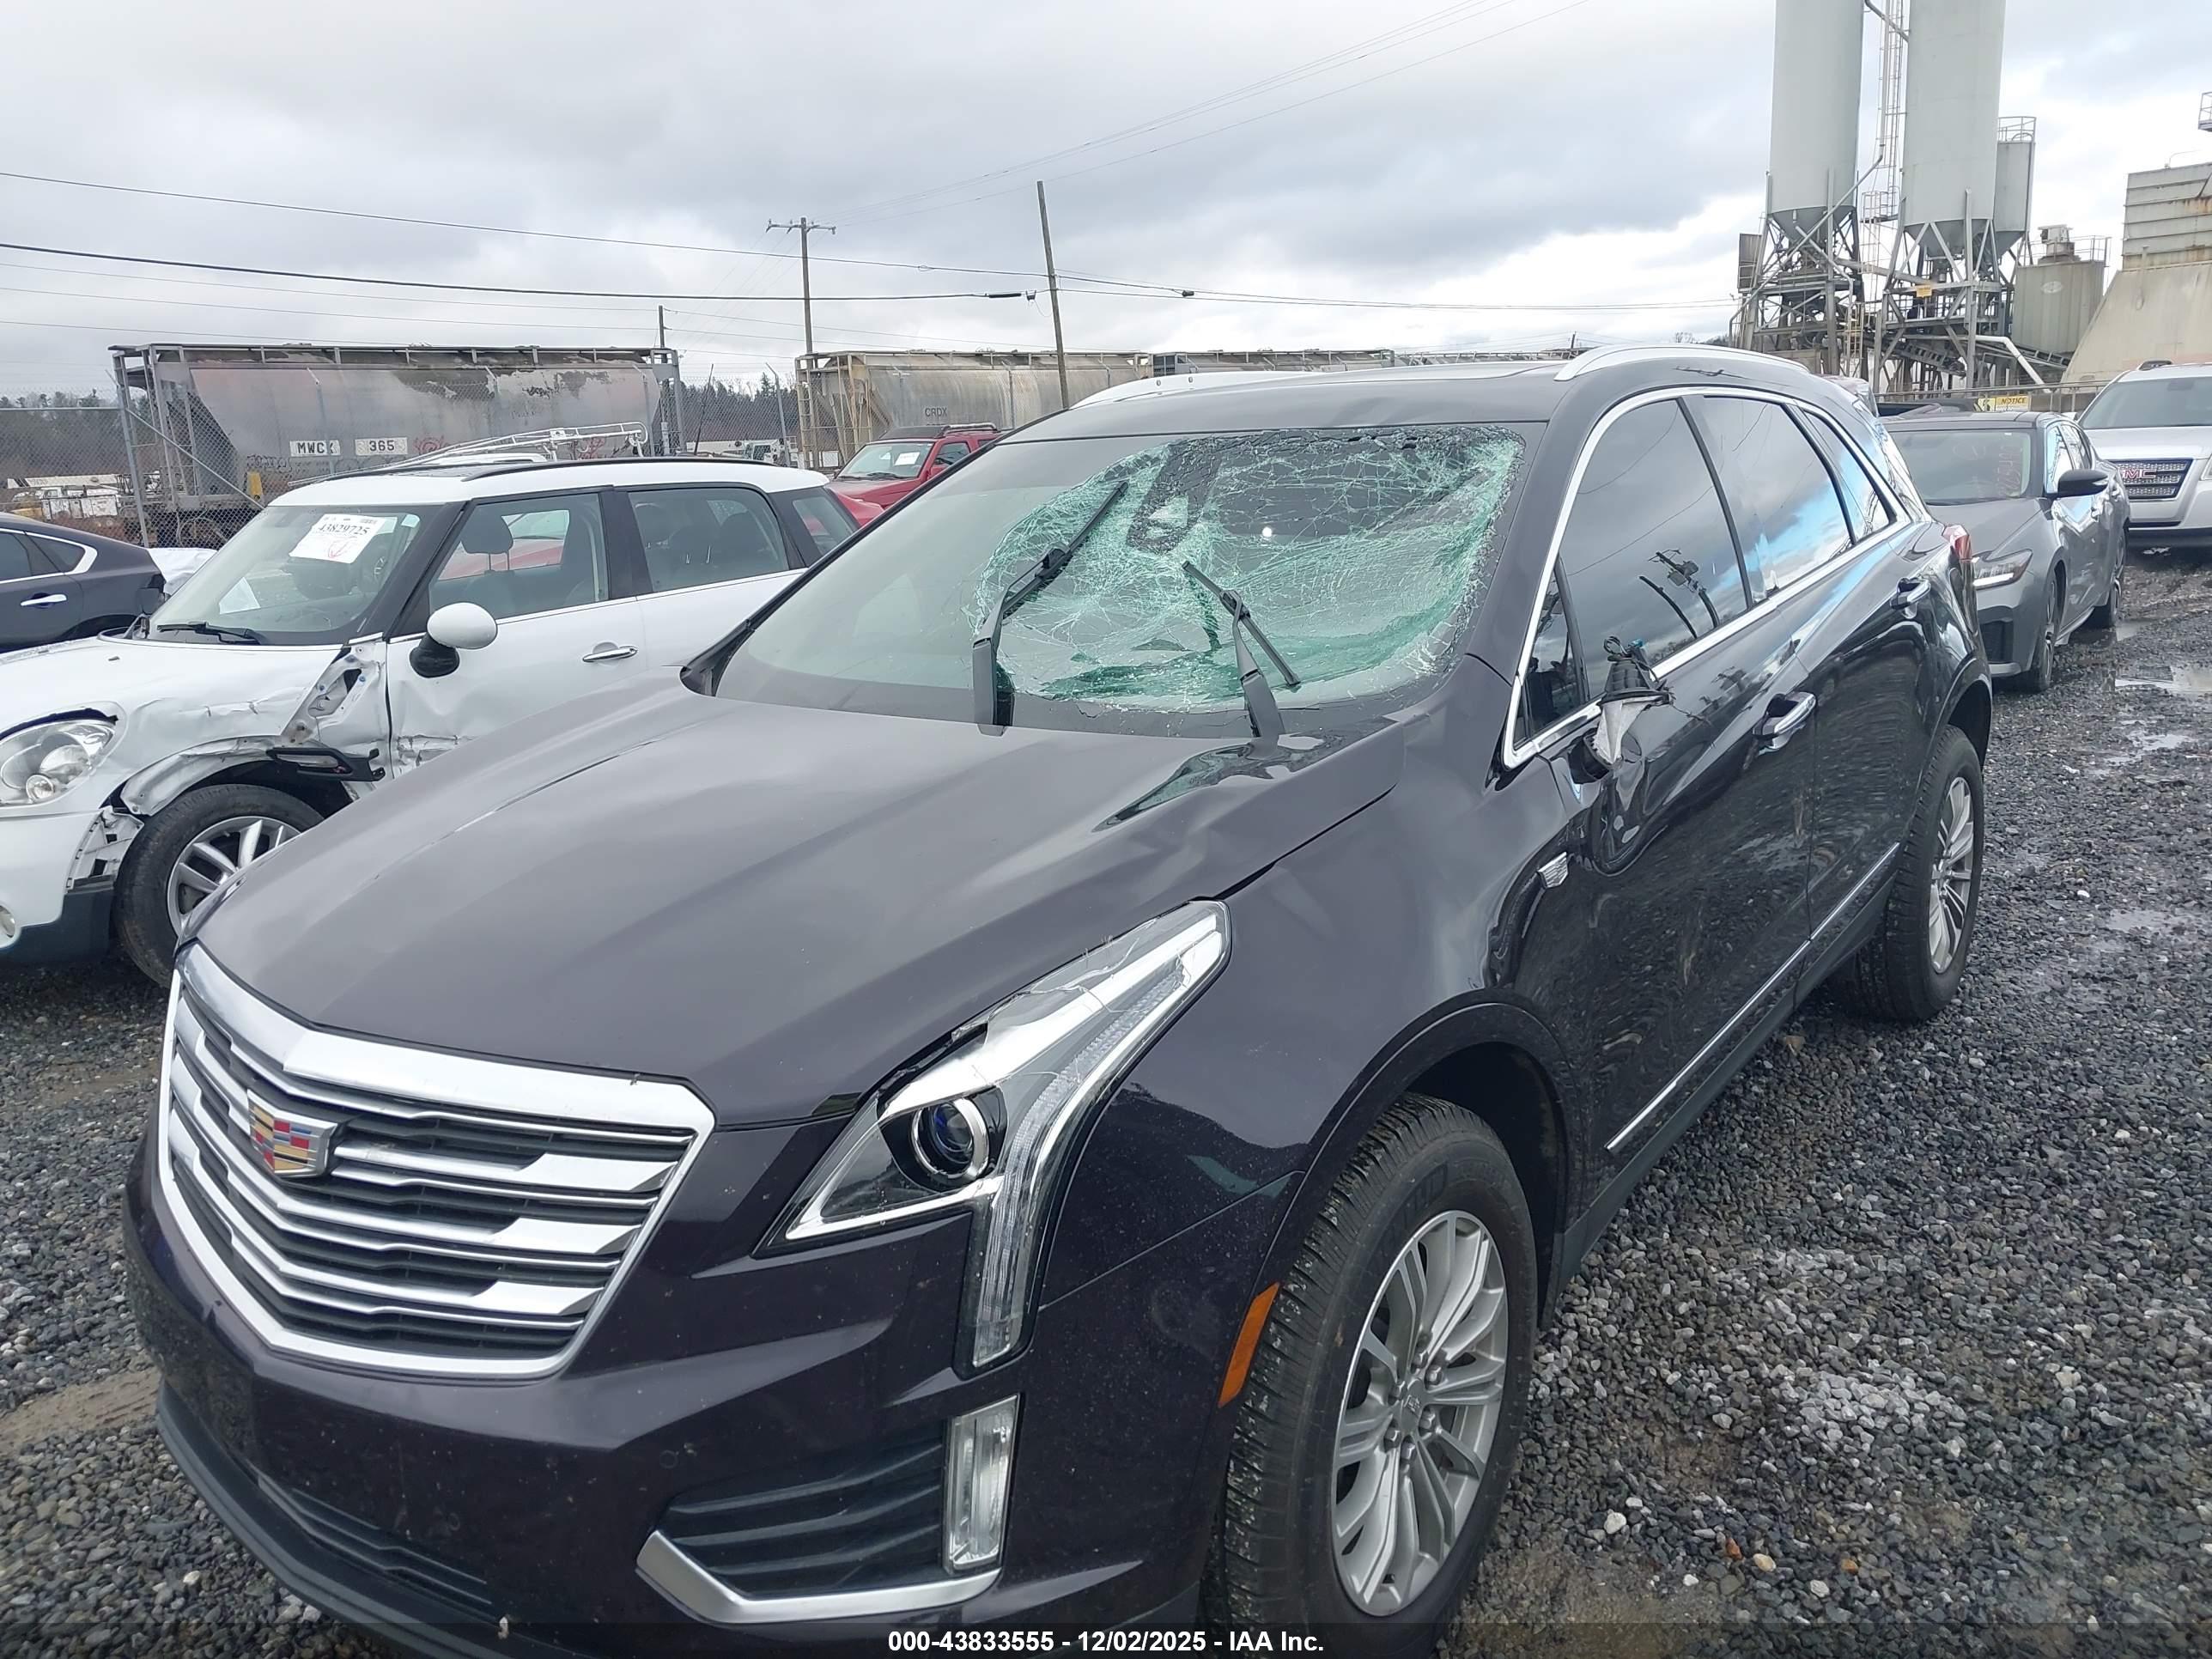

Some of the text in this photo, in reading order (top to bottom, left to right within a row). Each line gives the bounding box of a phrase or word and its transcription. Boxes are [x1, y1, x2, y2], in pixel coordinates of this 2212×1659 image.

[925, 407, 947, 417] CRDX
[369, 440, 395, 452] 365
[2120, 468, 2157, 479] MC
